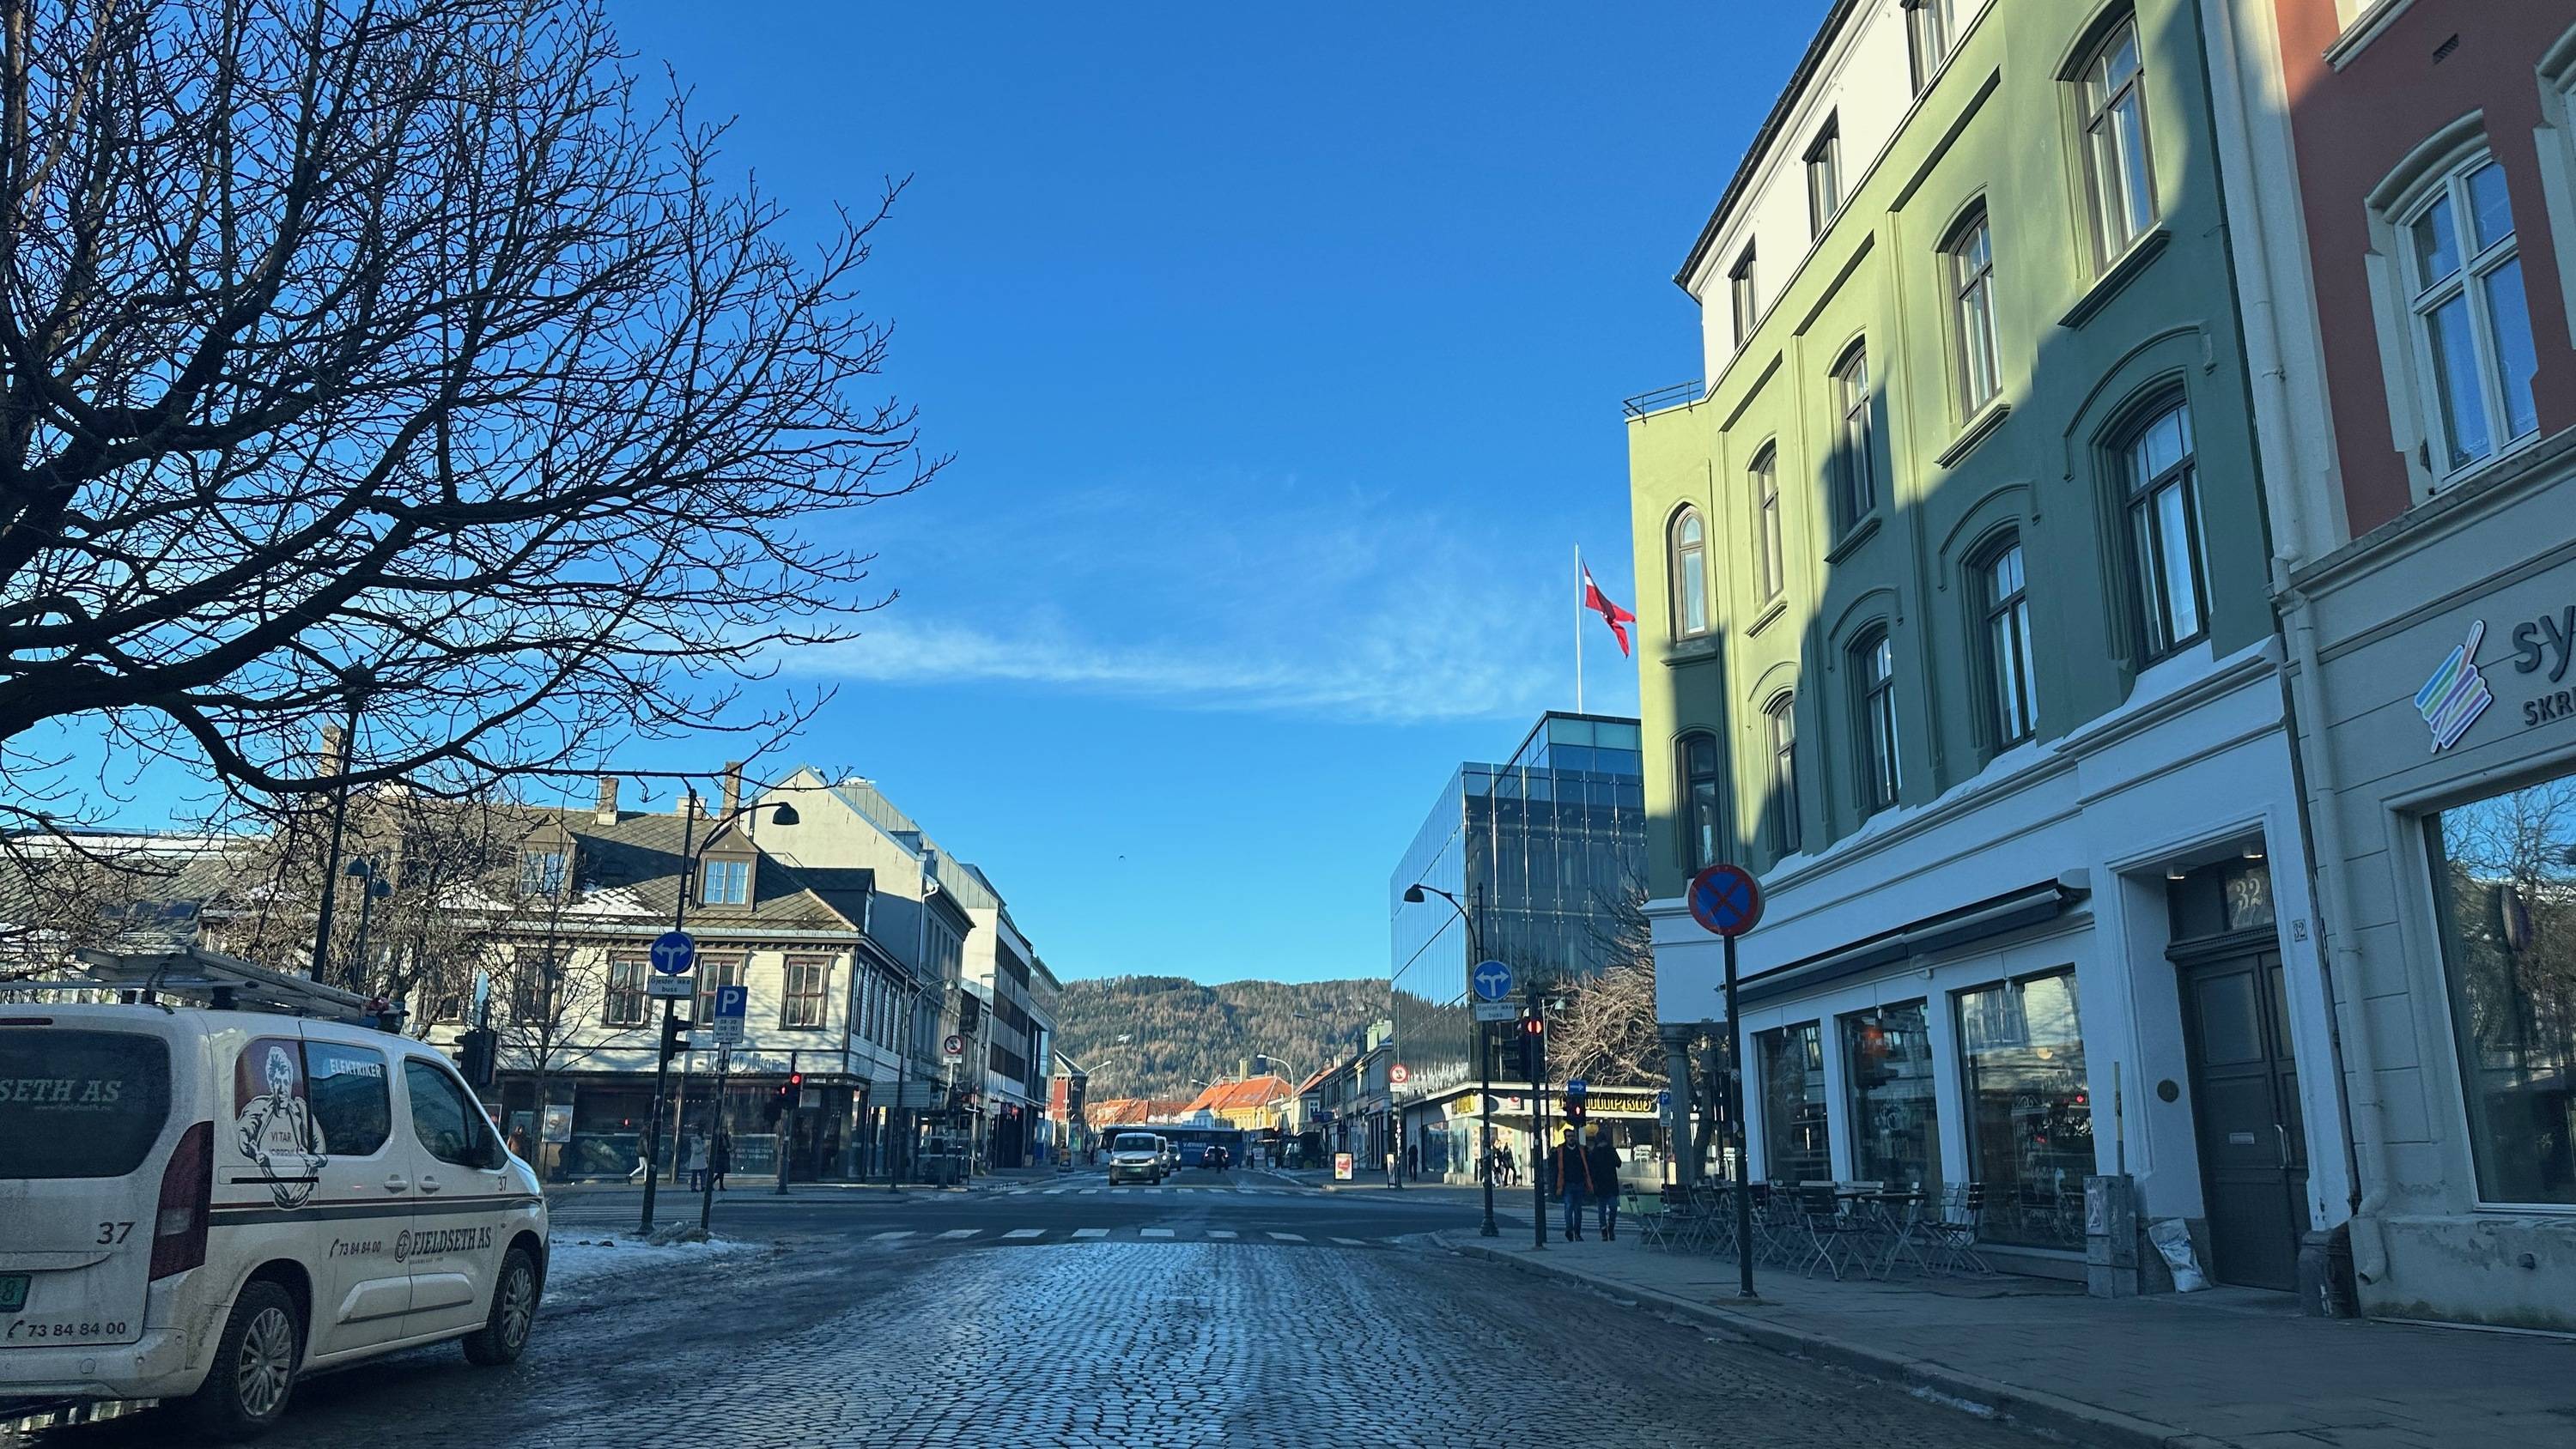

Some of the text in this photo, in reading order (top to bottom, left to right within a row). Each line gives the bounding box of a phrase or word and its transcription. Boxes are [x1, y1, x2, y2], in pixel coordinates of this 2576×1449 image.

[2236, 878, 2263, 910] 32
[2293, 922, 2306, 938] 32
[721, 990, 739, 1013] P
[330, 1058, 382, 1078] ELEKTRIKER
[79, 1080, 122, 1101] AS
[270, 1131, 291, 1143] VI TAR
[497, 1175, 507, 1191] 37
[97, 1222, 136, 1245] 37
[410, 1228, 476, 1257] FJELDSETH
[478, 1227, 492, 1249] AS
[339, 1241, 381, 1256] 73 84 84 00
[27, 1322, 126, 1337] 73 84 84 00
